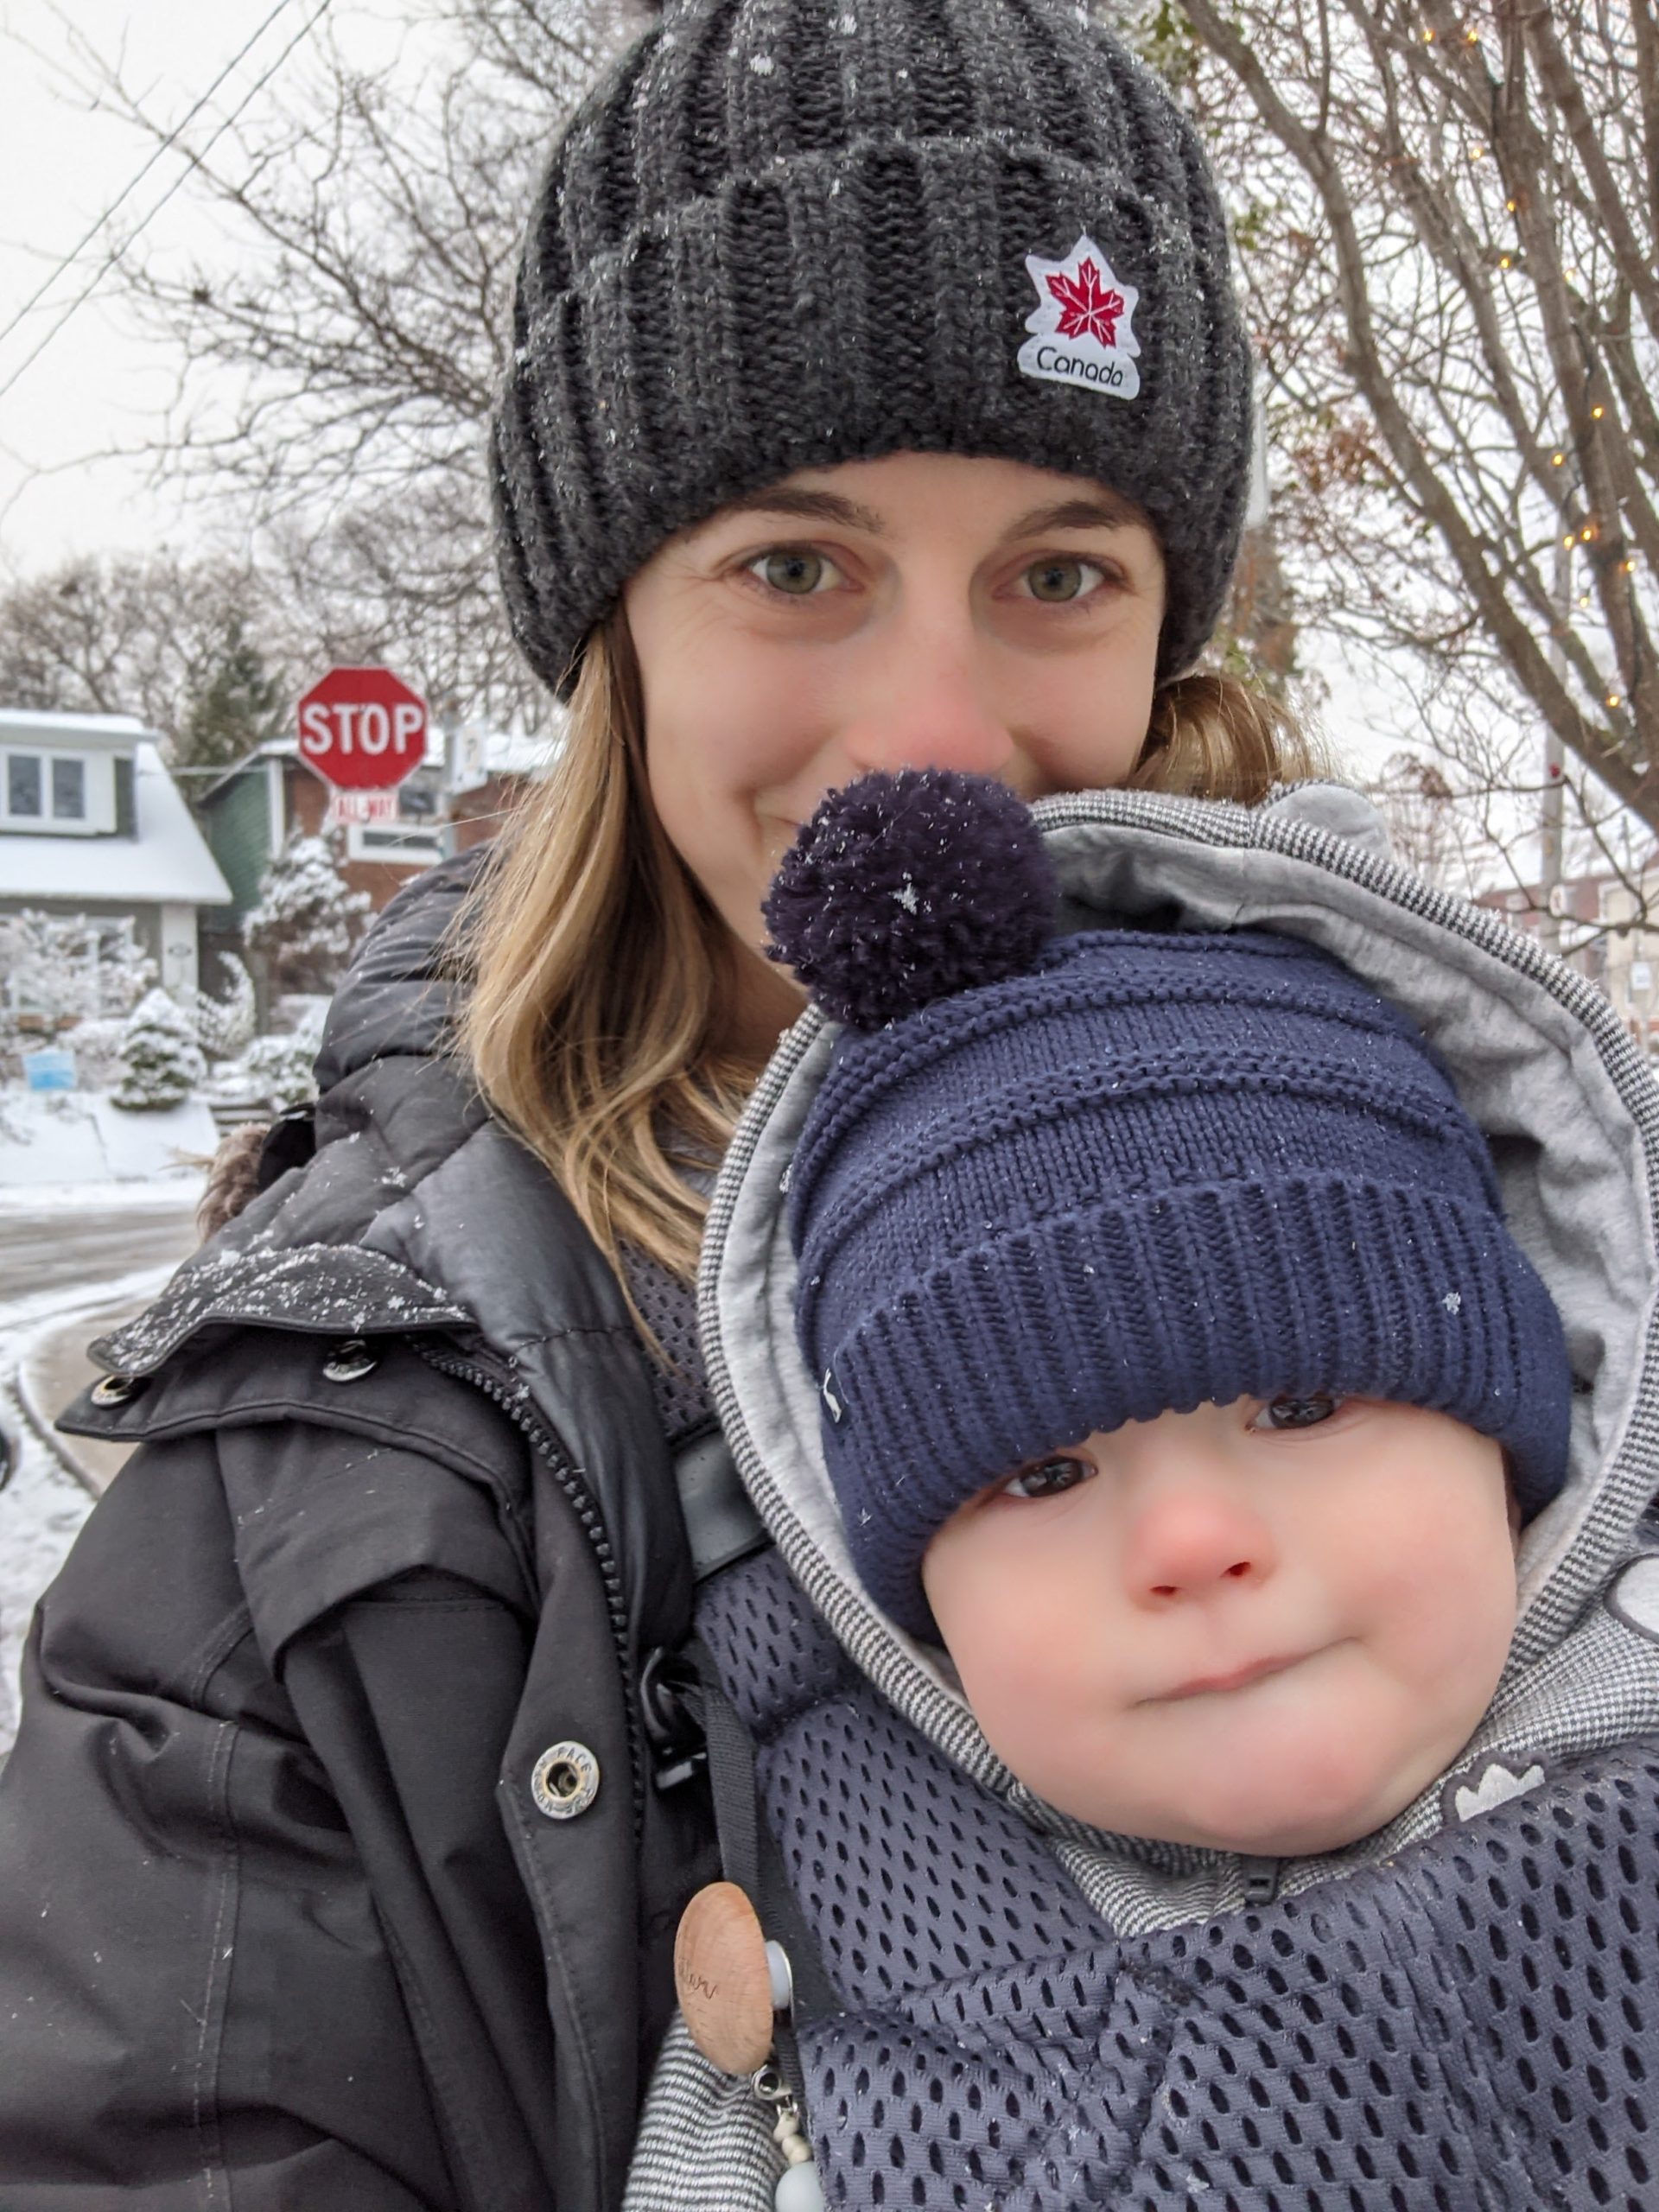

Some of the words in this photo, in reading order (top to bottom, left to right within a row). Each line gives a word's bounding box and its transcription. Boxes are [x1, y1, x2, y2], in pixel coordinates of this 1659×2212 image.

[1037, 346, 1123, 387] Canada
[303, 702, 422, 755] STOP
[556, 1745, 593, 1773] FACE
